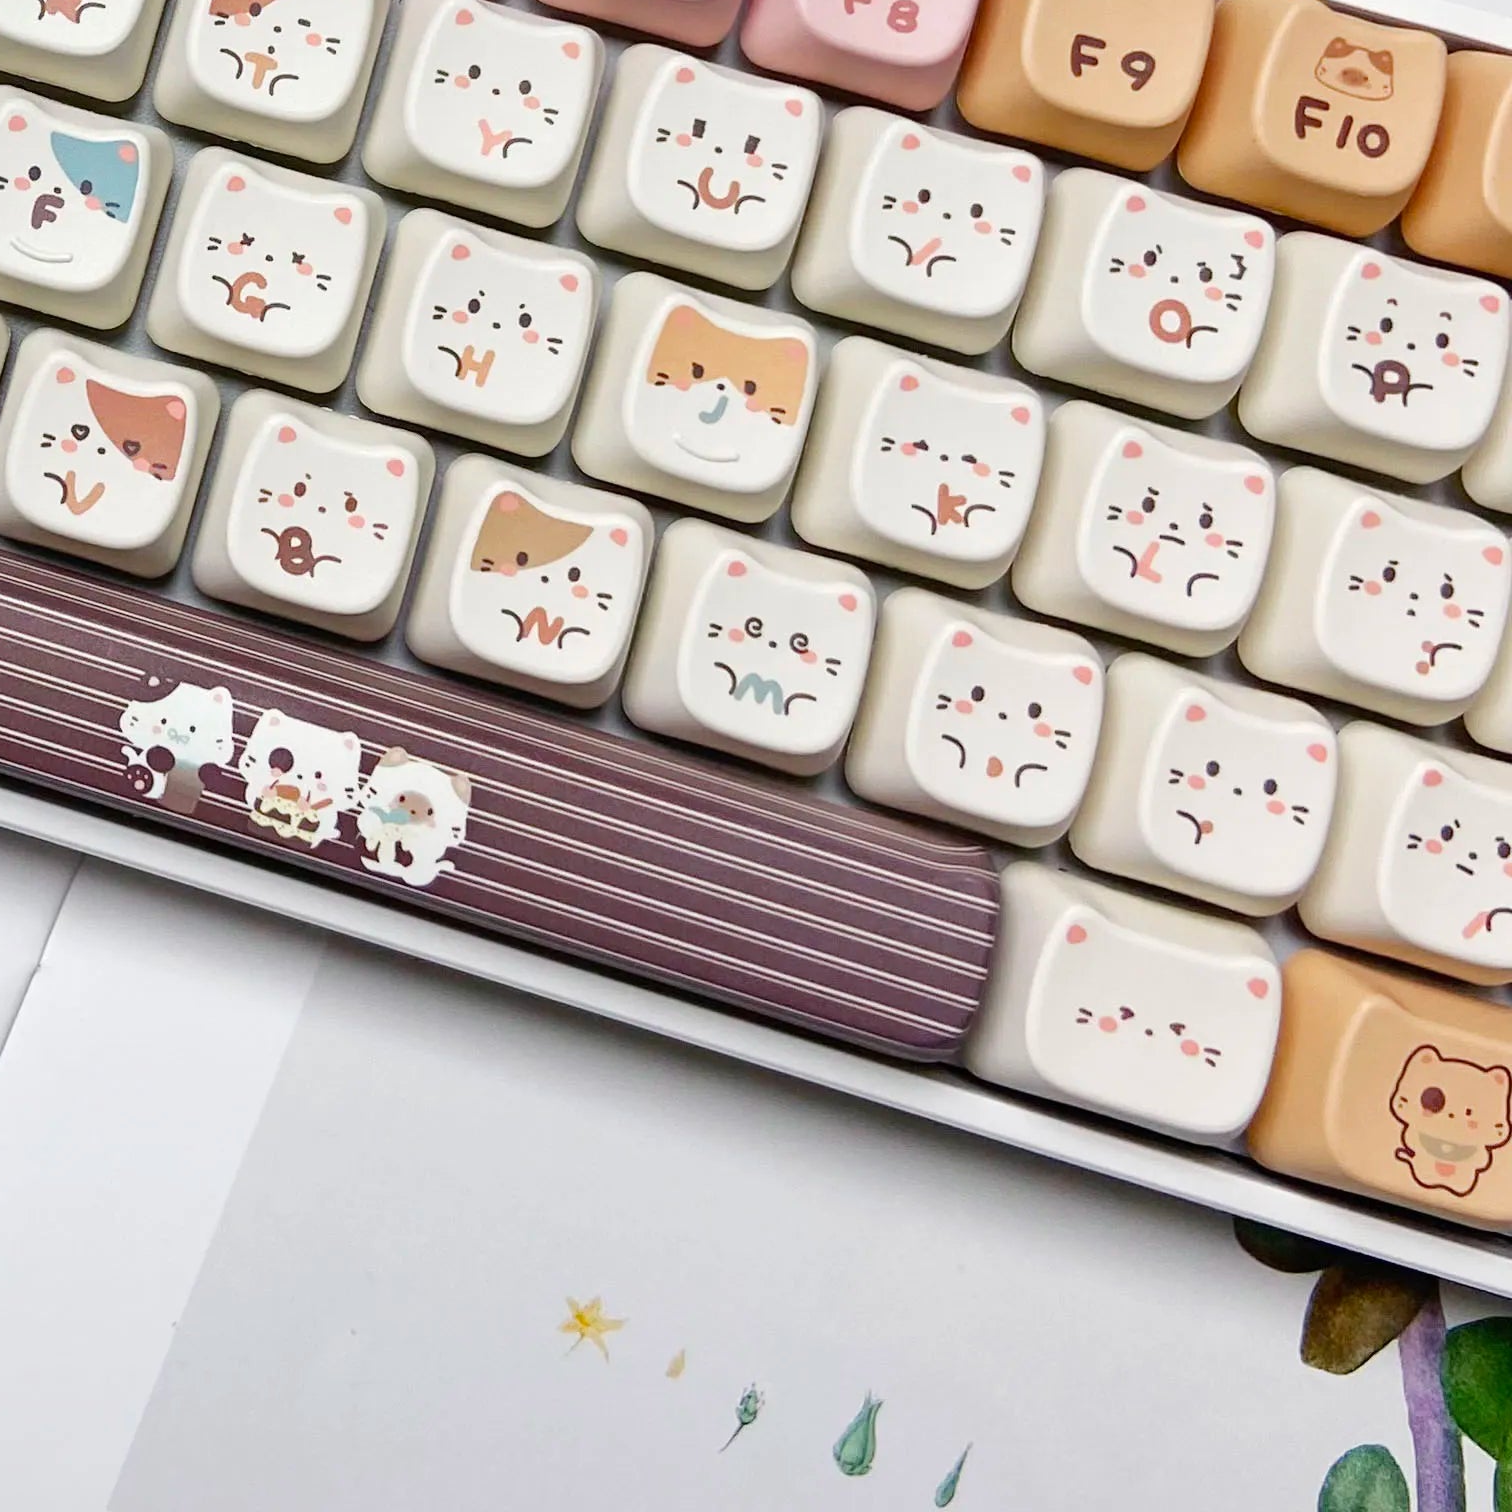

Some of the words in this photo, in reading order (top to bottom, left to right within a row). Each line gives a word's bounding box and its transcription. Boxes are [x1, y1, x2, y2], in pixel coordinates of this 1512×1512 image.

[245, 51, 278, 89] T
[1070, 34, 1156, 91] F9
[478, 119, 512, 155] Y
[1294, 95, 1390, 159] F10
[699, 166, 740, 209] U
[32, 194, 64, 229] F
[232, 272, 268, 319] G
[1149, 299, 1191, 343] O
[457, 345, 495, 387] H
[1374, 359, 1410, 403] P
[699, 395, 728, 424] J
[65, 470, 105, 515] V
[276, 525, 314, 576] B
[1138, 541, 1162, 583] L
[521, 607, 564, 644] N
